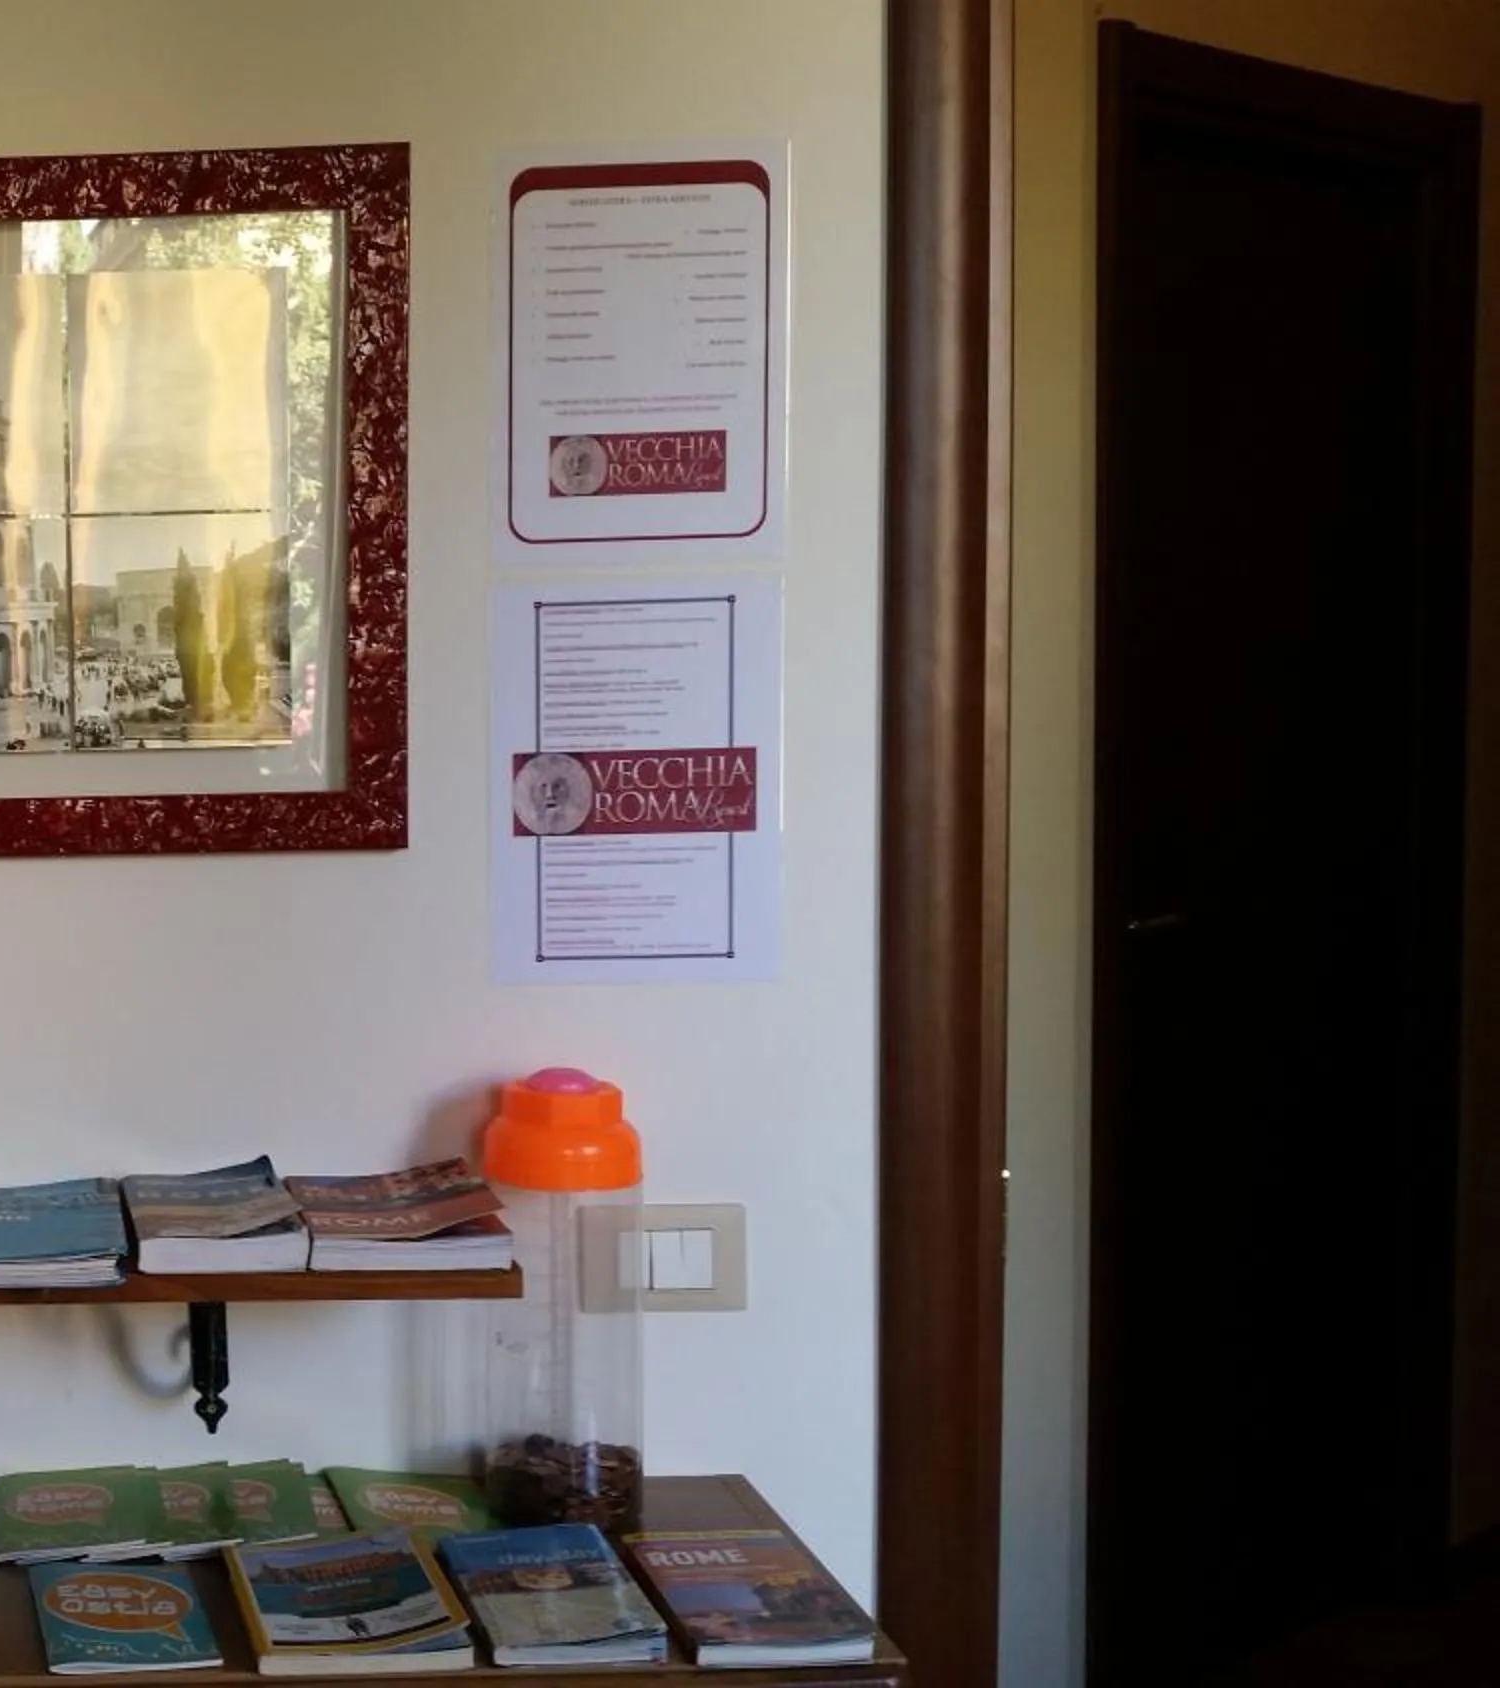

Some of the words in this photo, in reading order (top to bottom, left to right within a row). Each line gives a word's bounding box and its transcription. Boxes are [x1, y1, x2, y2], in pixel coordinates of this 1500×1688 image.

[605, 435, 725, 461] VECCHIA
[607, 462, 686, 488] ROMA
[590, 754, 754, 790] VECCHIA
[594, 789, 702, 823] ROMA
[645, 1548, 750, 1567] ROME
